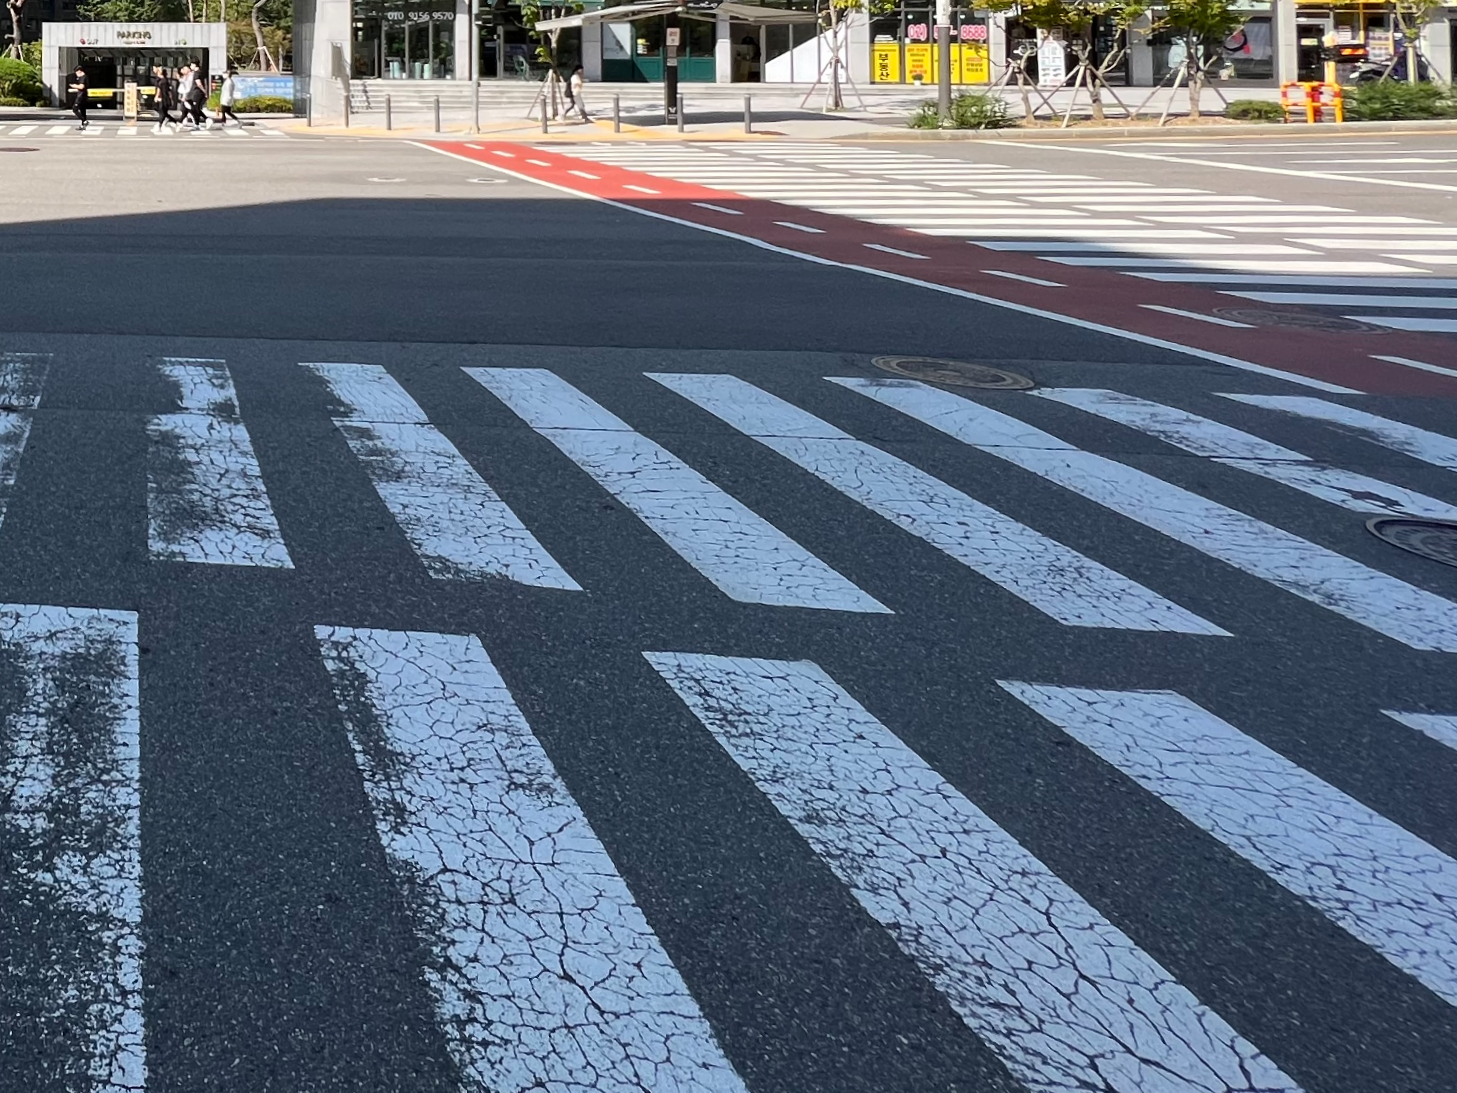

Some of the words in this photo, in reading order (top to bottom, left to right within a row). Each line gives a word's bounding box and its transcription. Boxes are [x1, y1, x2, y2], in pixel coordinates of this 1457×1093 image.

[387, 11, 405, 20] 010
[408, 11, 430, 20] 9156
[432, 11, 455, 20] 9570
[960, 25, 988, 39] 8688
[878, 53, 891, 81] 부동산
